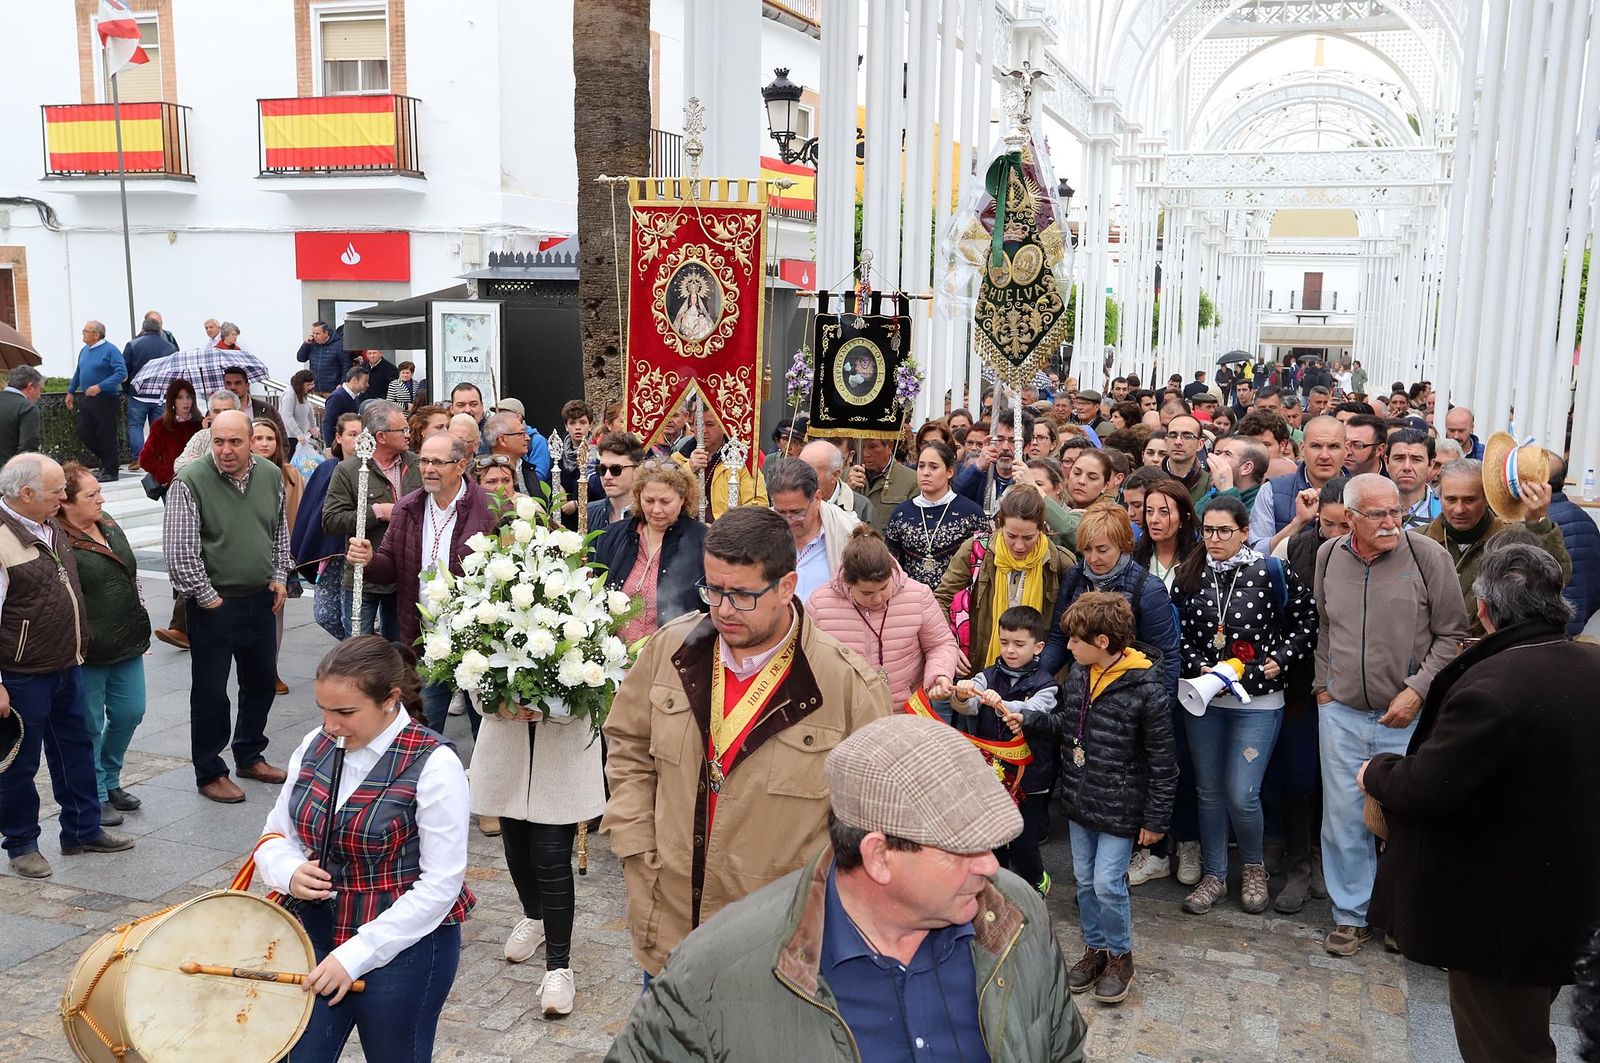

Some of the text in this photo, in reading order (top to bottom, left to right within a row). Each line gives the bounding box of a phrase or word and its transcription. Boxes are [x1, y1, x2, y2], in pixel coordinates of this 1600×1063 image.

[988, 283, 1046, 302] HUELVA
[452, 355, 479, 363] VELAS
[870, 345, 884, 366] CON
[747, 680, 769, 707] HDAD
[769, 663, 781, 678] DE
